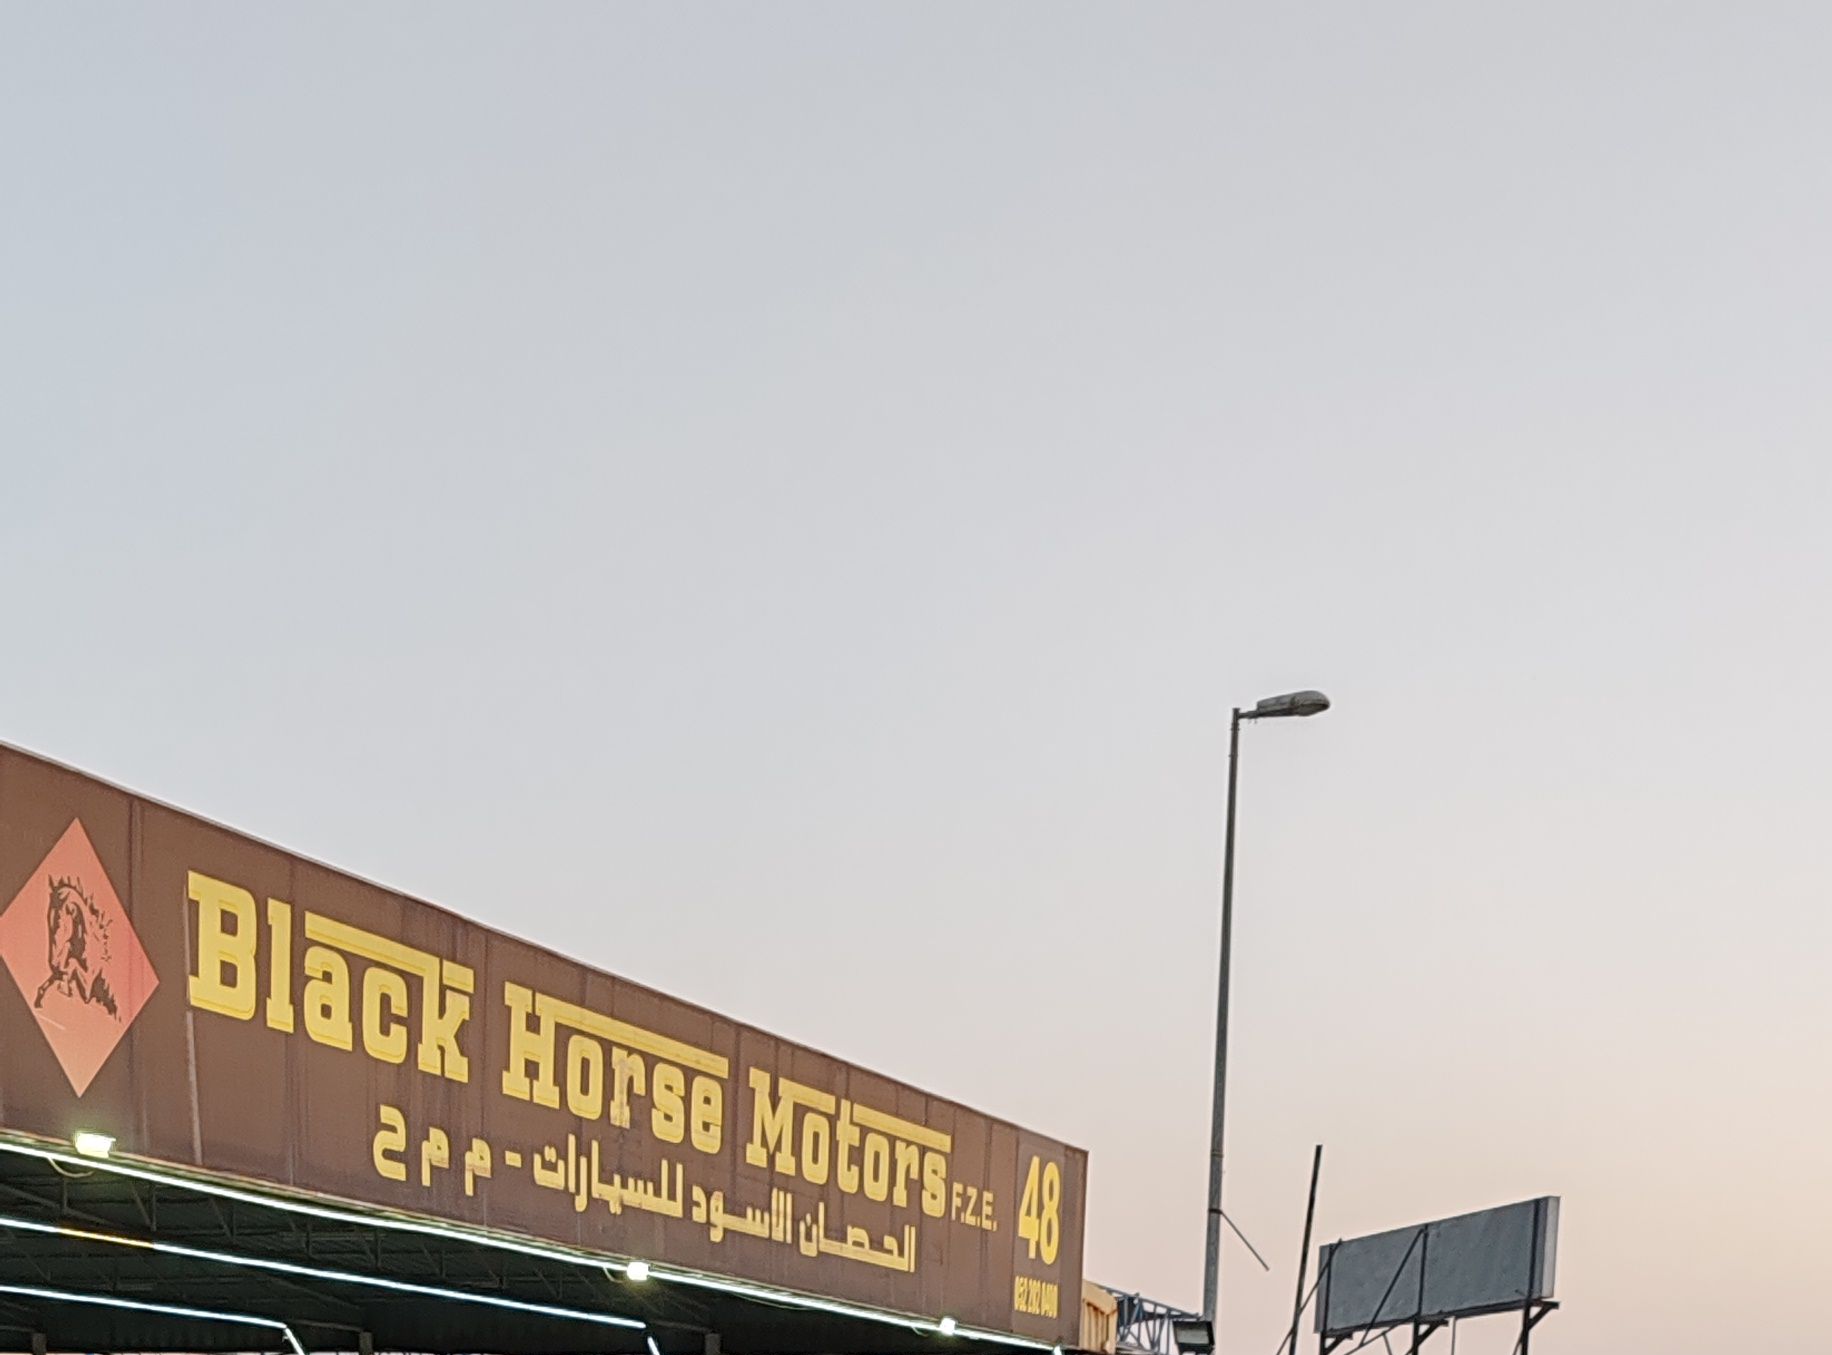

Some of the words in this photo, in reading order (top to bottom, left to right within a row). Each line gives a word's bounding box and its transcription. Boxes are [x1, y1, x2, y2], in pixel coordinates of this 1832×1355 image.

[187, 870, 475, 1083] Black
[502, 981, 729, 1154] Horse
[746, 1066, 952, 1218] Motors
[533, 1133, 684, 1219] للسيارات
[692, 1184, 793, 1243] الاسود
[1018, 1155, 1060, 1265] 48
[799, 1201, 917, 1273] الحصان
